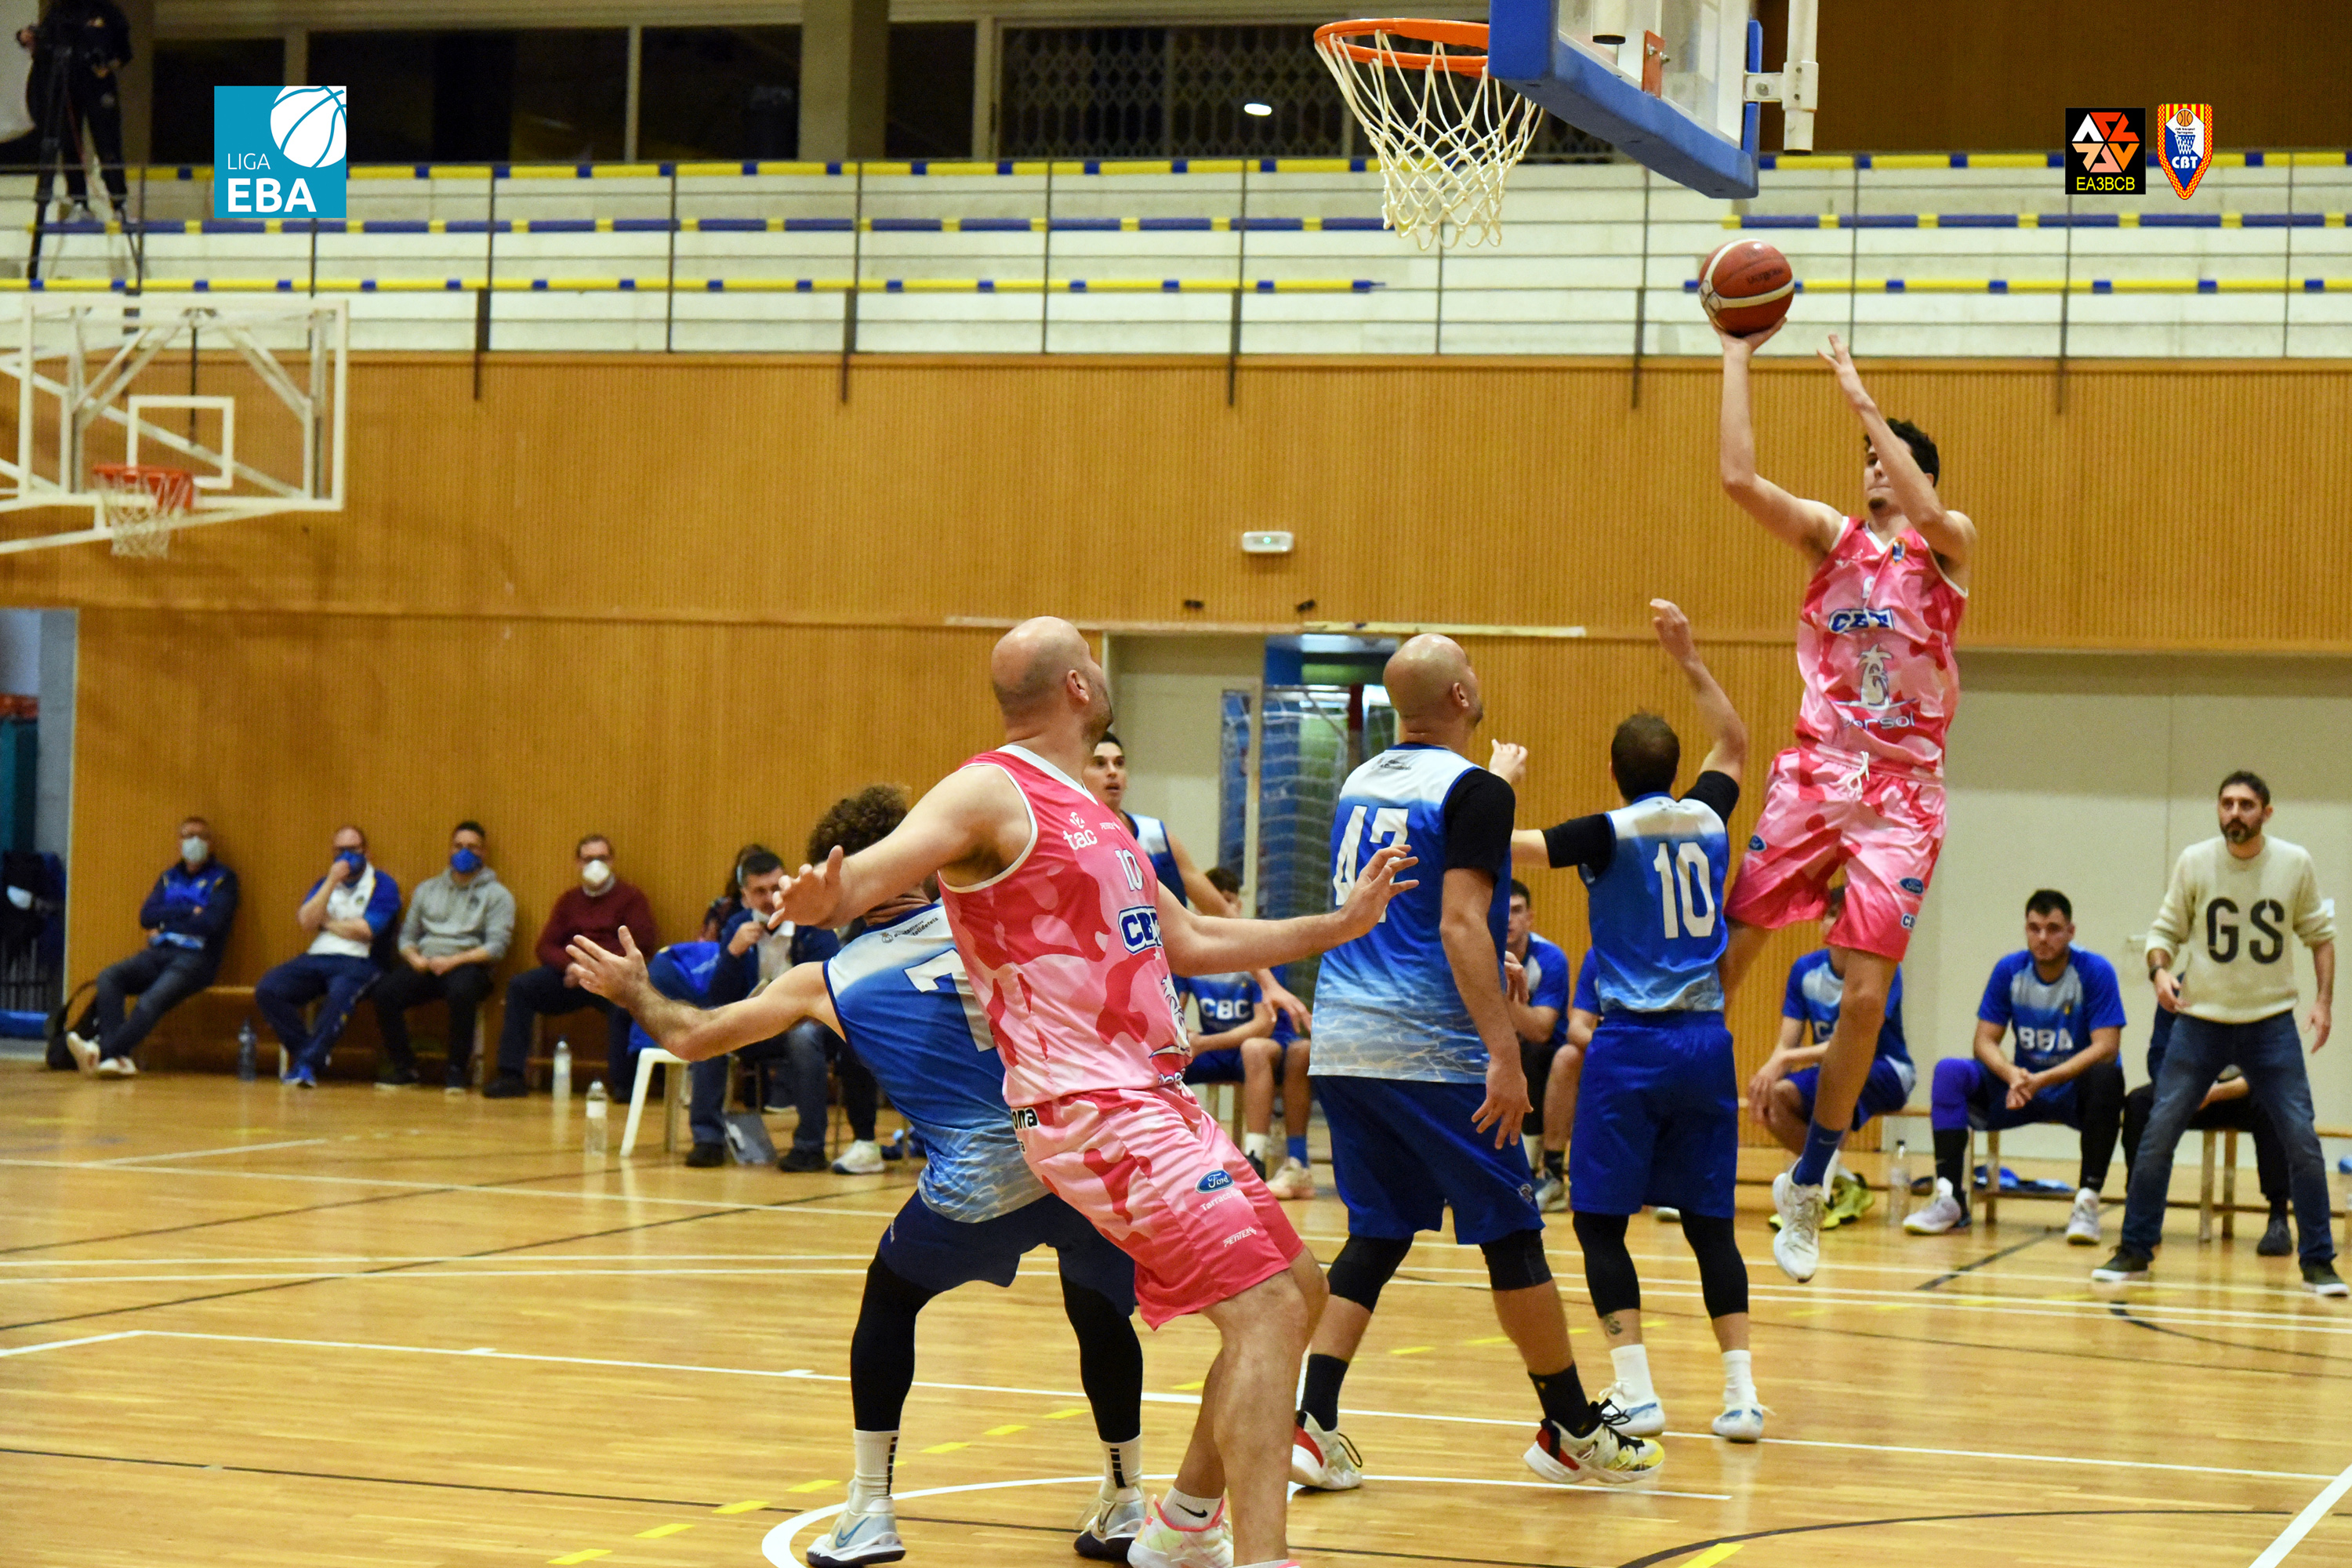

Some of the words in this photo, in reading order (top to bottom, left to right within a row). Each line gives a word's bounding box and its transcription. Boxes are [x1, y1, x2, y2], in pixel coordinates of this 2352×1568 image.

[1062, 829, 1098, 851] tac
[1114, 848, 1144, 891] 10
[1653, 841, 1715, 939] 10
[2206, 897, 2285, 964] GS
[1199, 997, 1250, 1020] CBC
[1207, 1172, 1229, 1189] Ford
[1200, 1192, 1232, 1211] Tarraco
